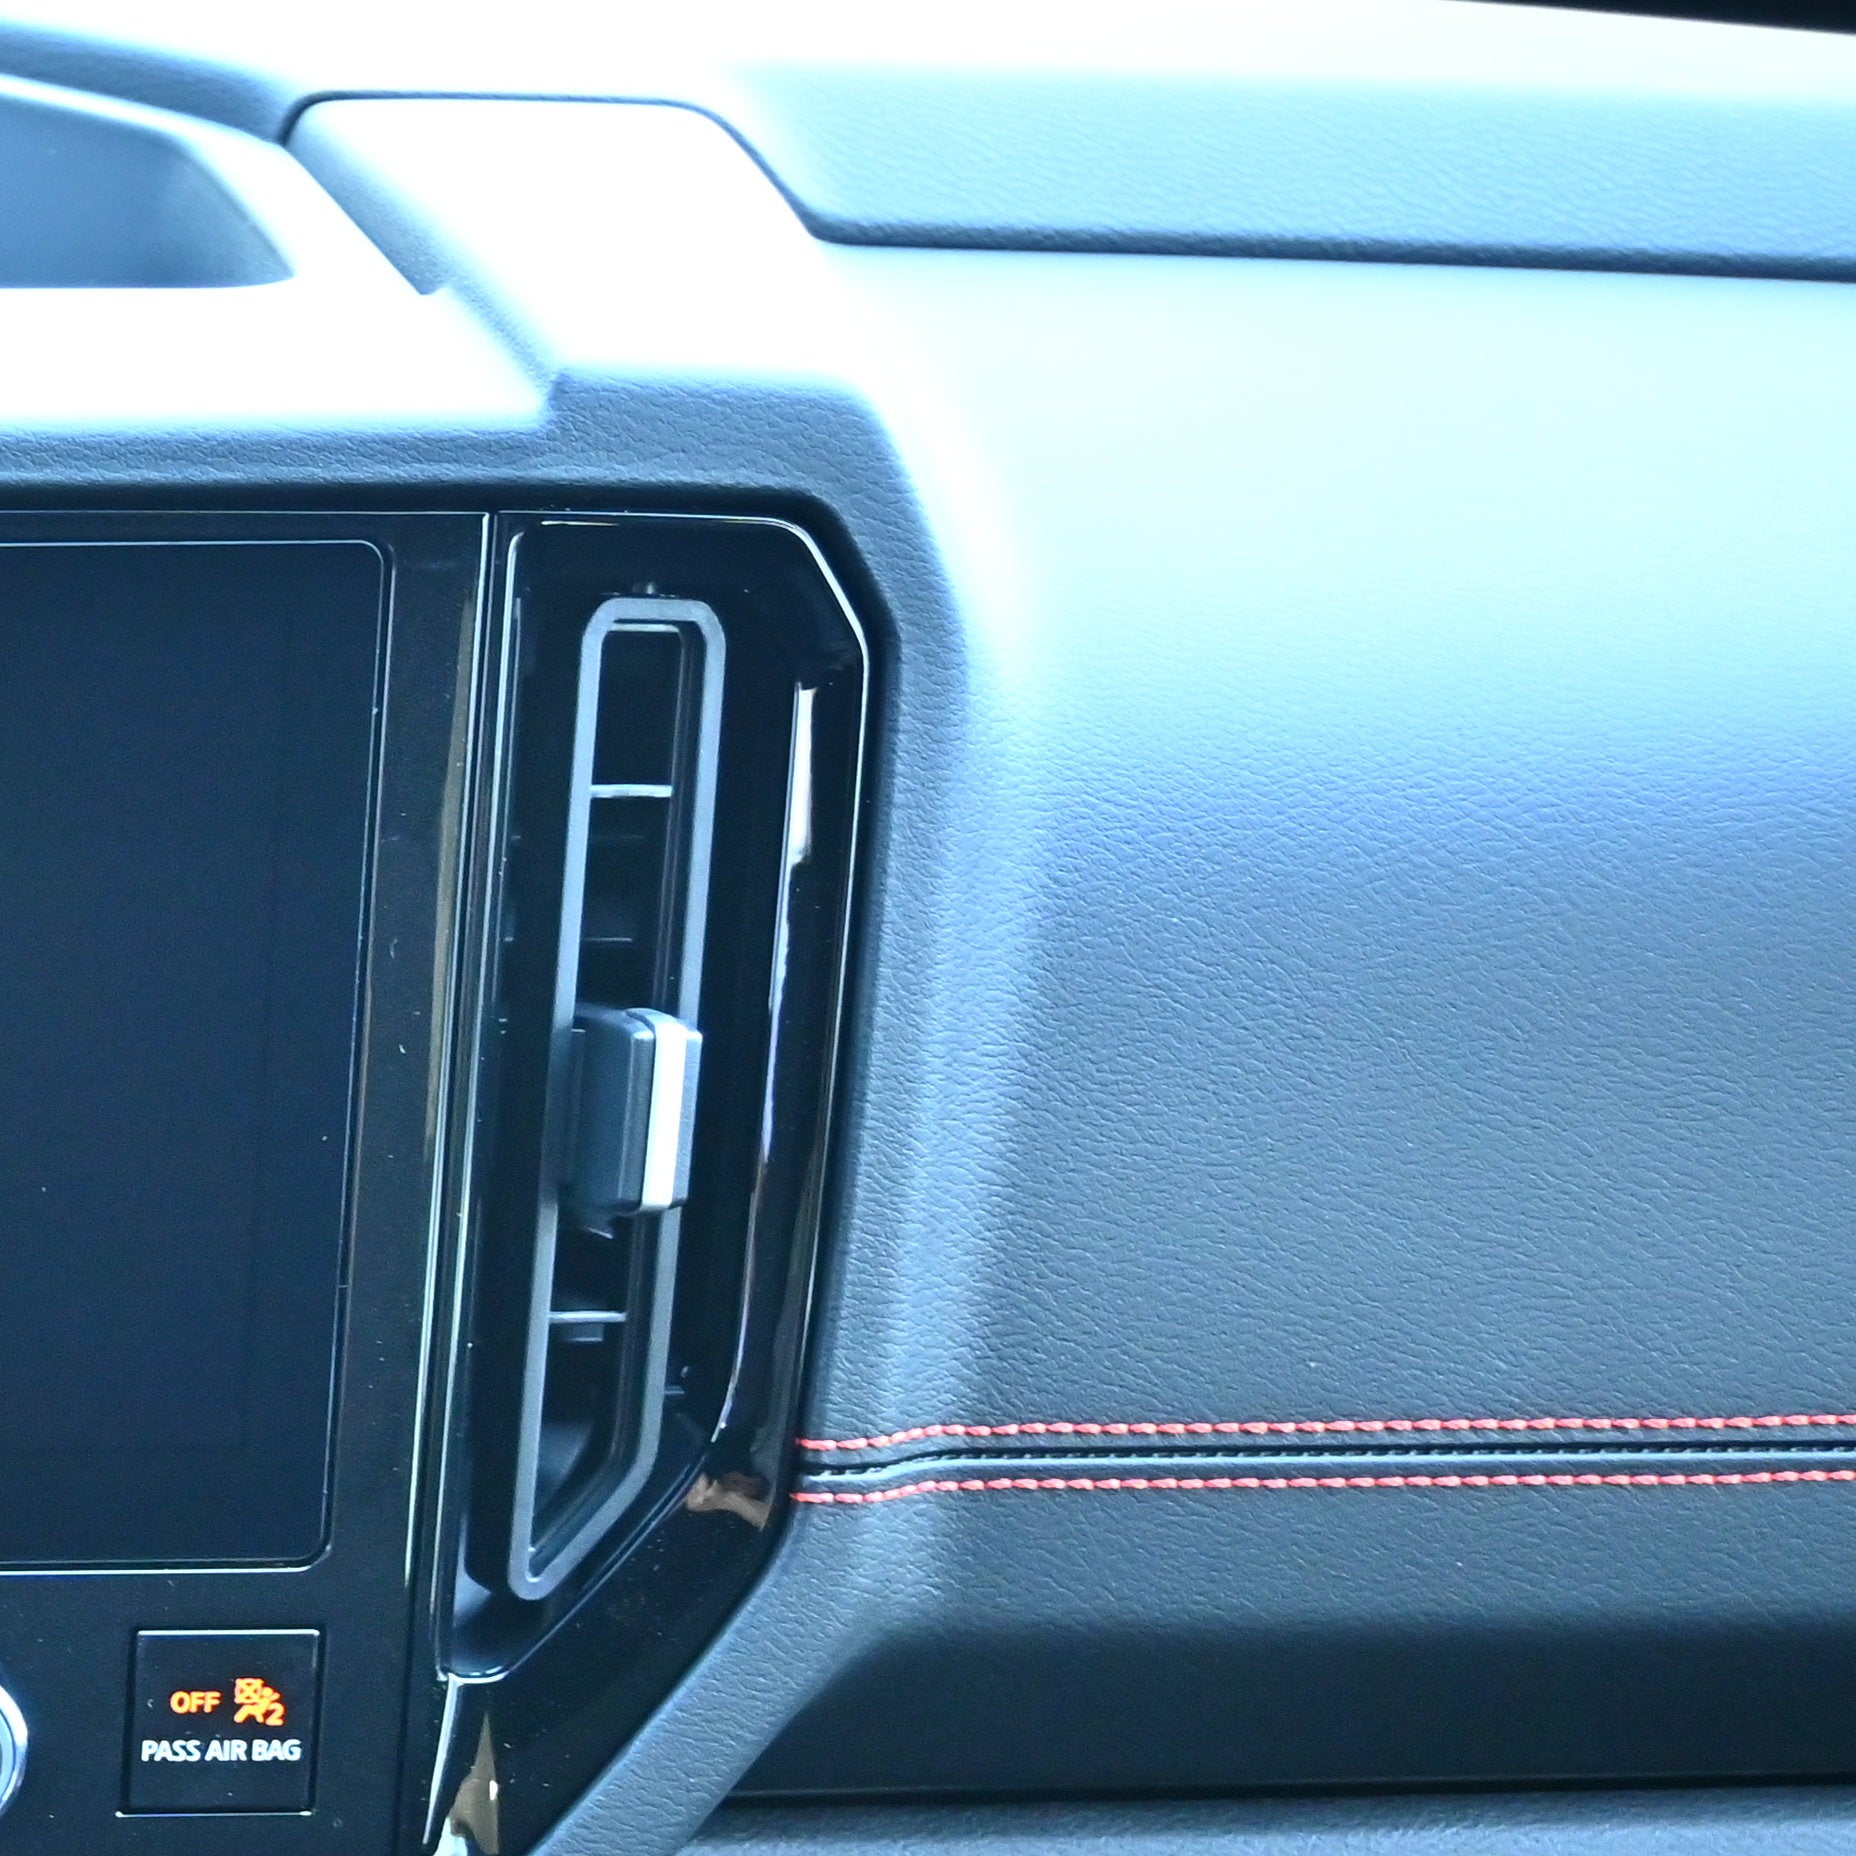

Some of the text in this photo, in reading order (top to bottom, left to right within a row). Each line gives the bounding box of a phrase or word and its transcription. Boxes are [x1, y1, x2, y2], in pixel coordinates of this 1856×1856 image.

[170, 1690, 220, 1714] OFF
[141, 1739, 302, 1762] PASS AIR BAG
